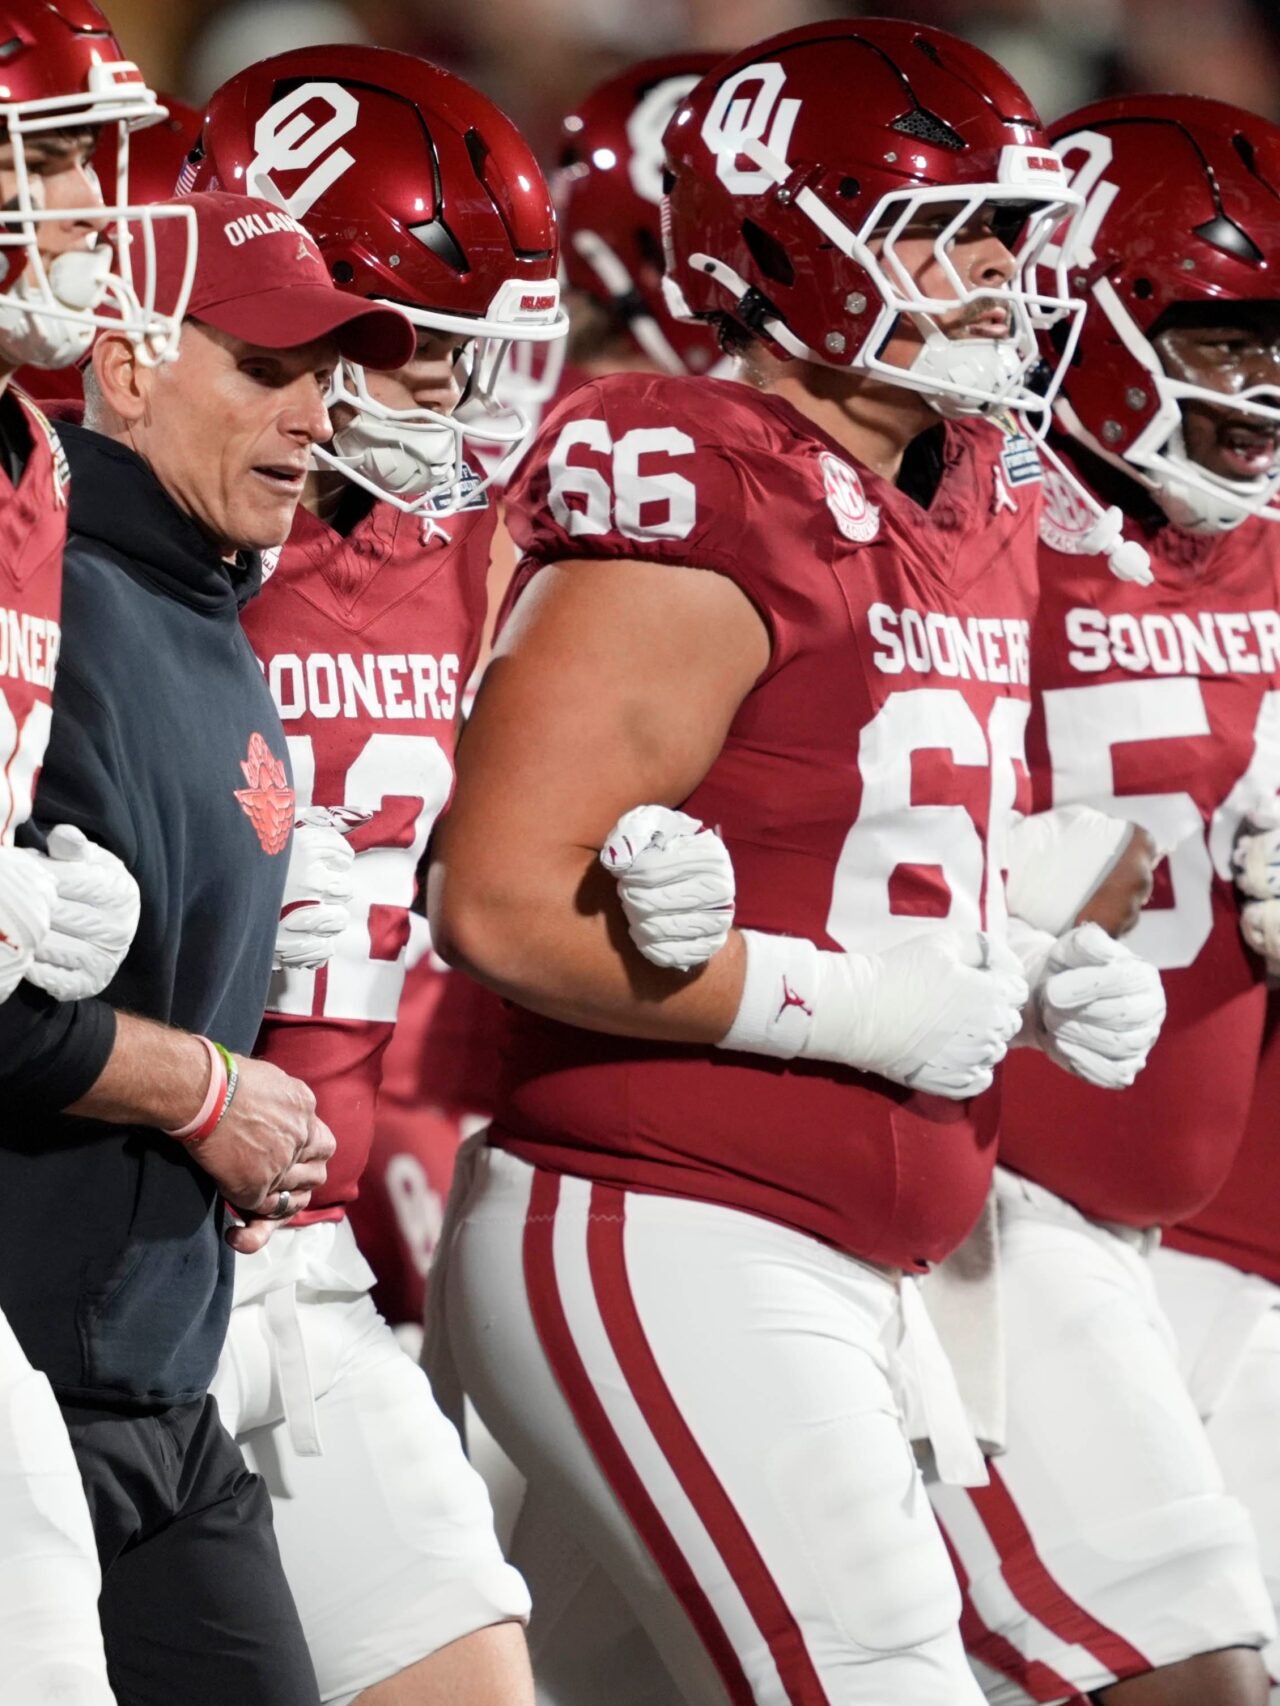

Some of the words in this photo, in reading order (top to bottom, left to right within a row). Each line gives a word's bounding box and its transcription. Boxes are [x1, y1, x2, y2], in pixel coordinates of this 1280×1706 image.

[246, 82, 359, 219] OU
[701, 62, 803, 195] OU
[223, 211, 320, 250] OKLAH
[547, 418, 696, 543] 66
[257, 654, 459, 719] OONERS
[1065, 607, 1280, 674] SOONER
